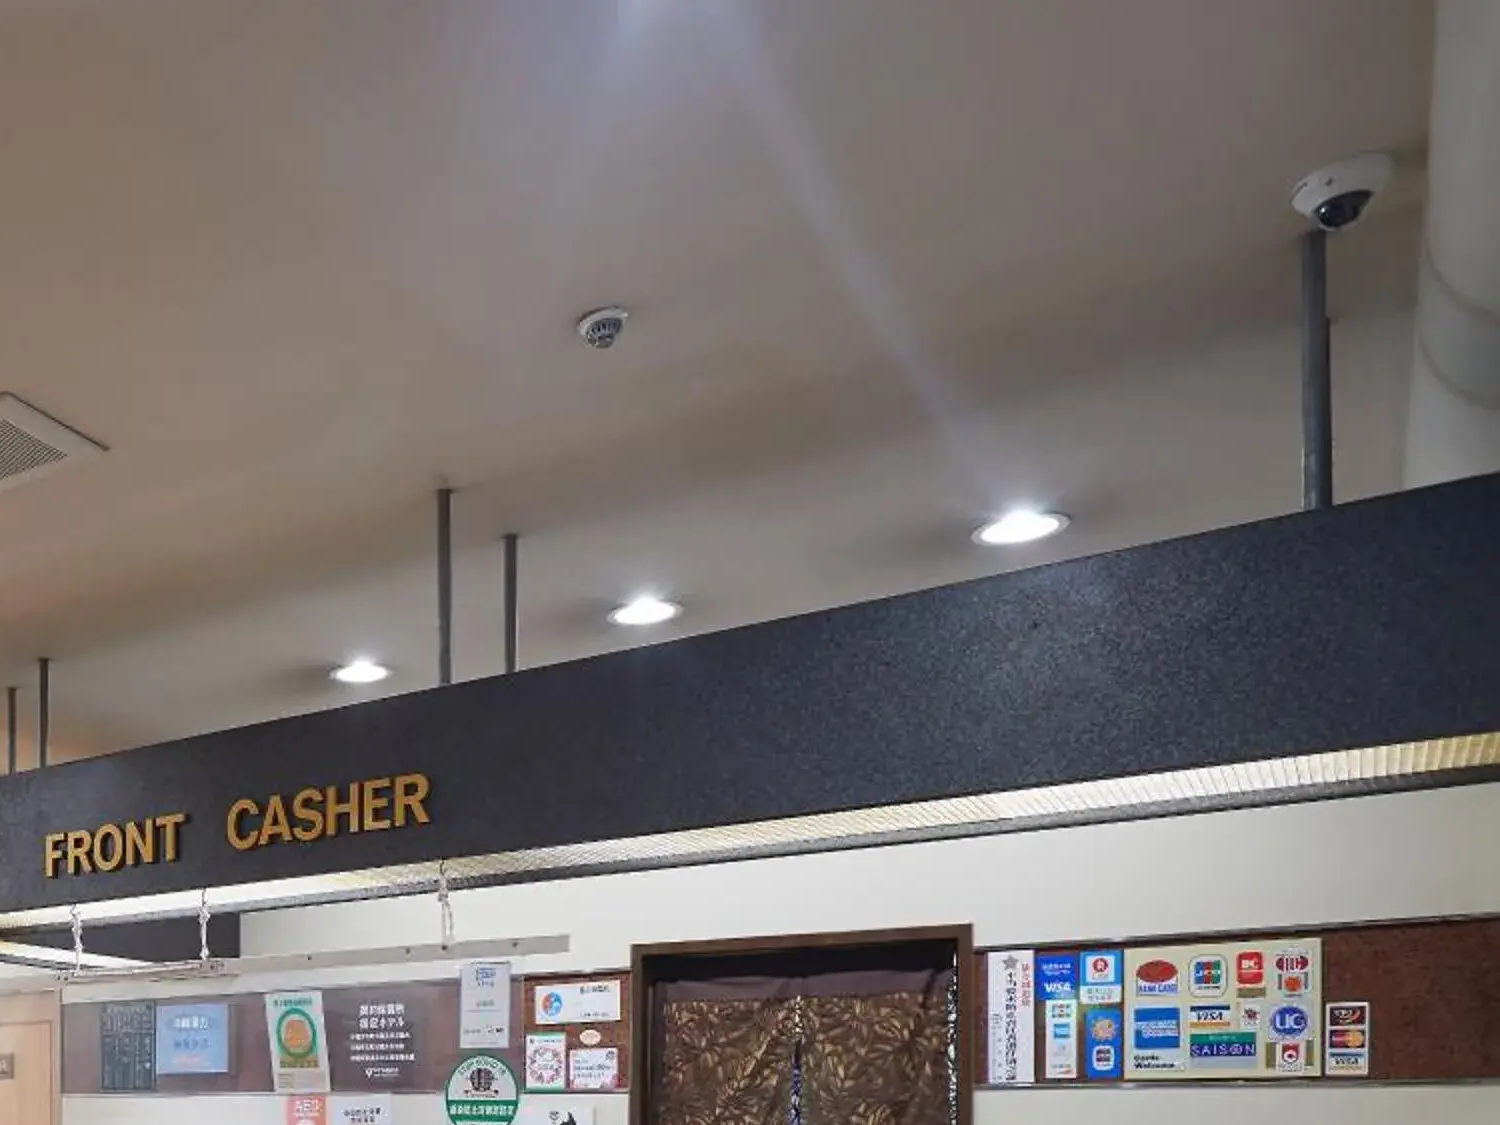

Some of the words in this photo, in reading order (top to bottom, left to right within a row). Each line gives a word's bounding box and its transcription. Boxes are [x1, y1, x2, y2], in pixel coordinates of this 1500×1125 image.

[43, 812, 189, 878] FRONT
[226, 772, 432, 851] CASHER
[1043, 981, 1072, 993] VISA
[1195, 1011, 1224, 1021] VISA
[1275, 1013, 1307, 1029] UC
[1191, 1043, 1255, 1056] SAISON
